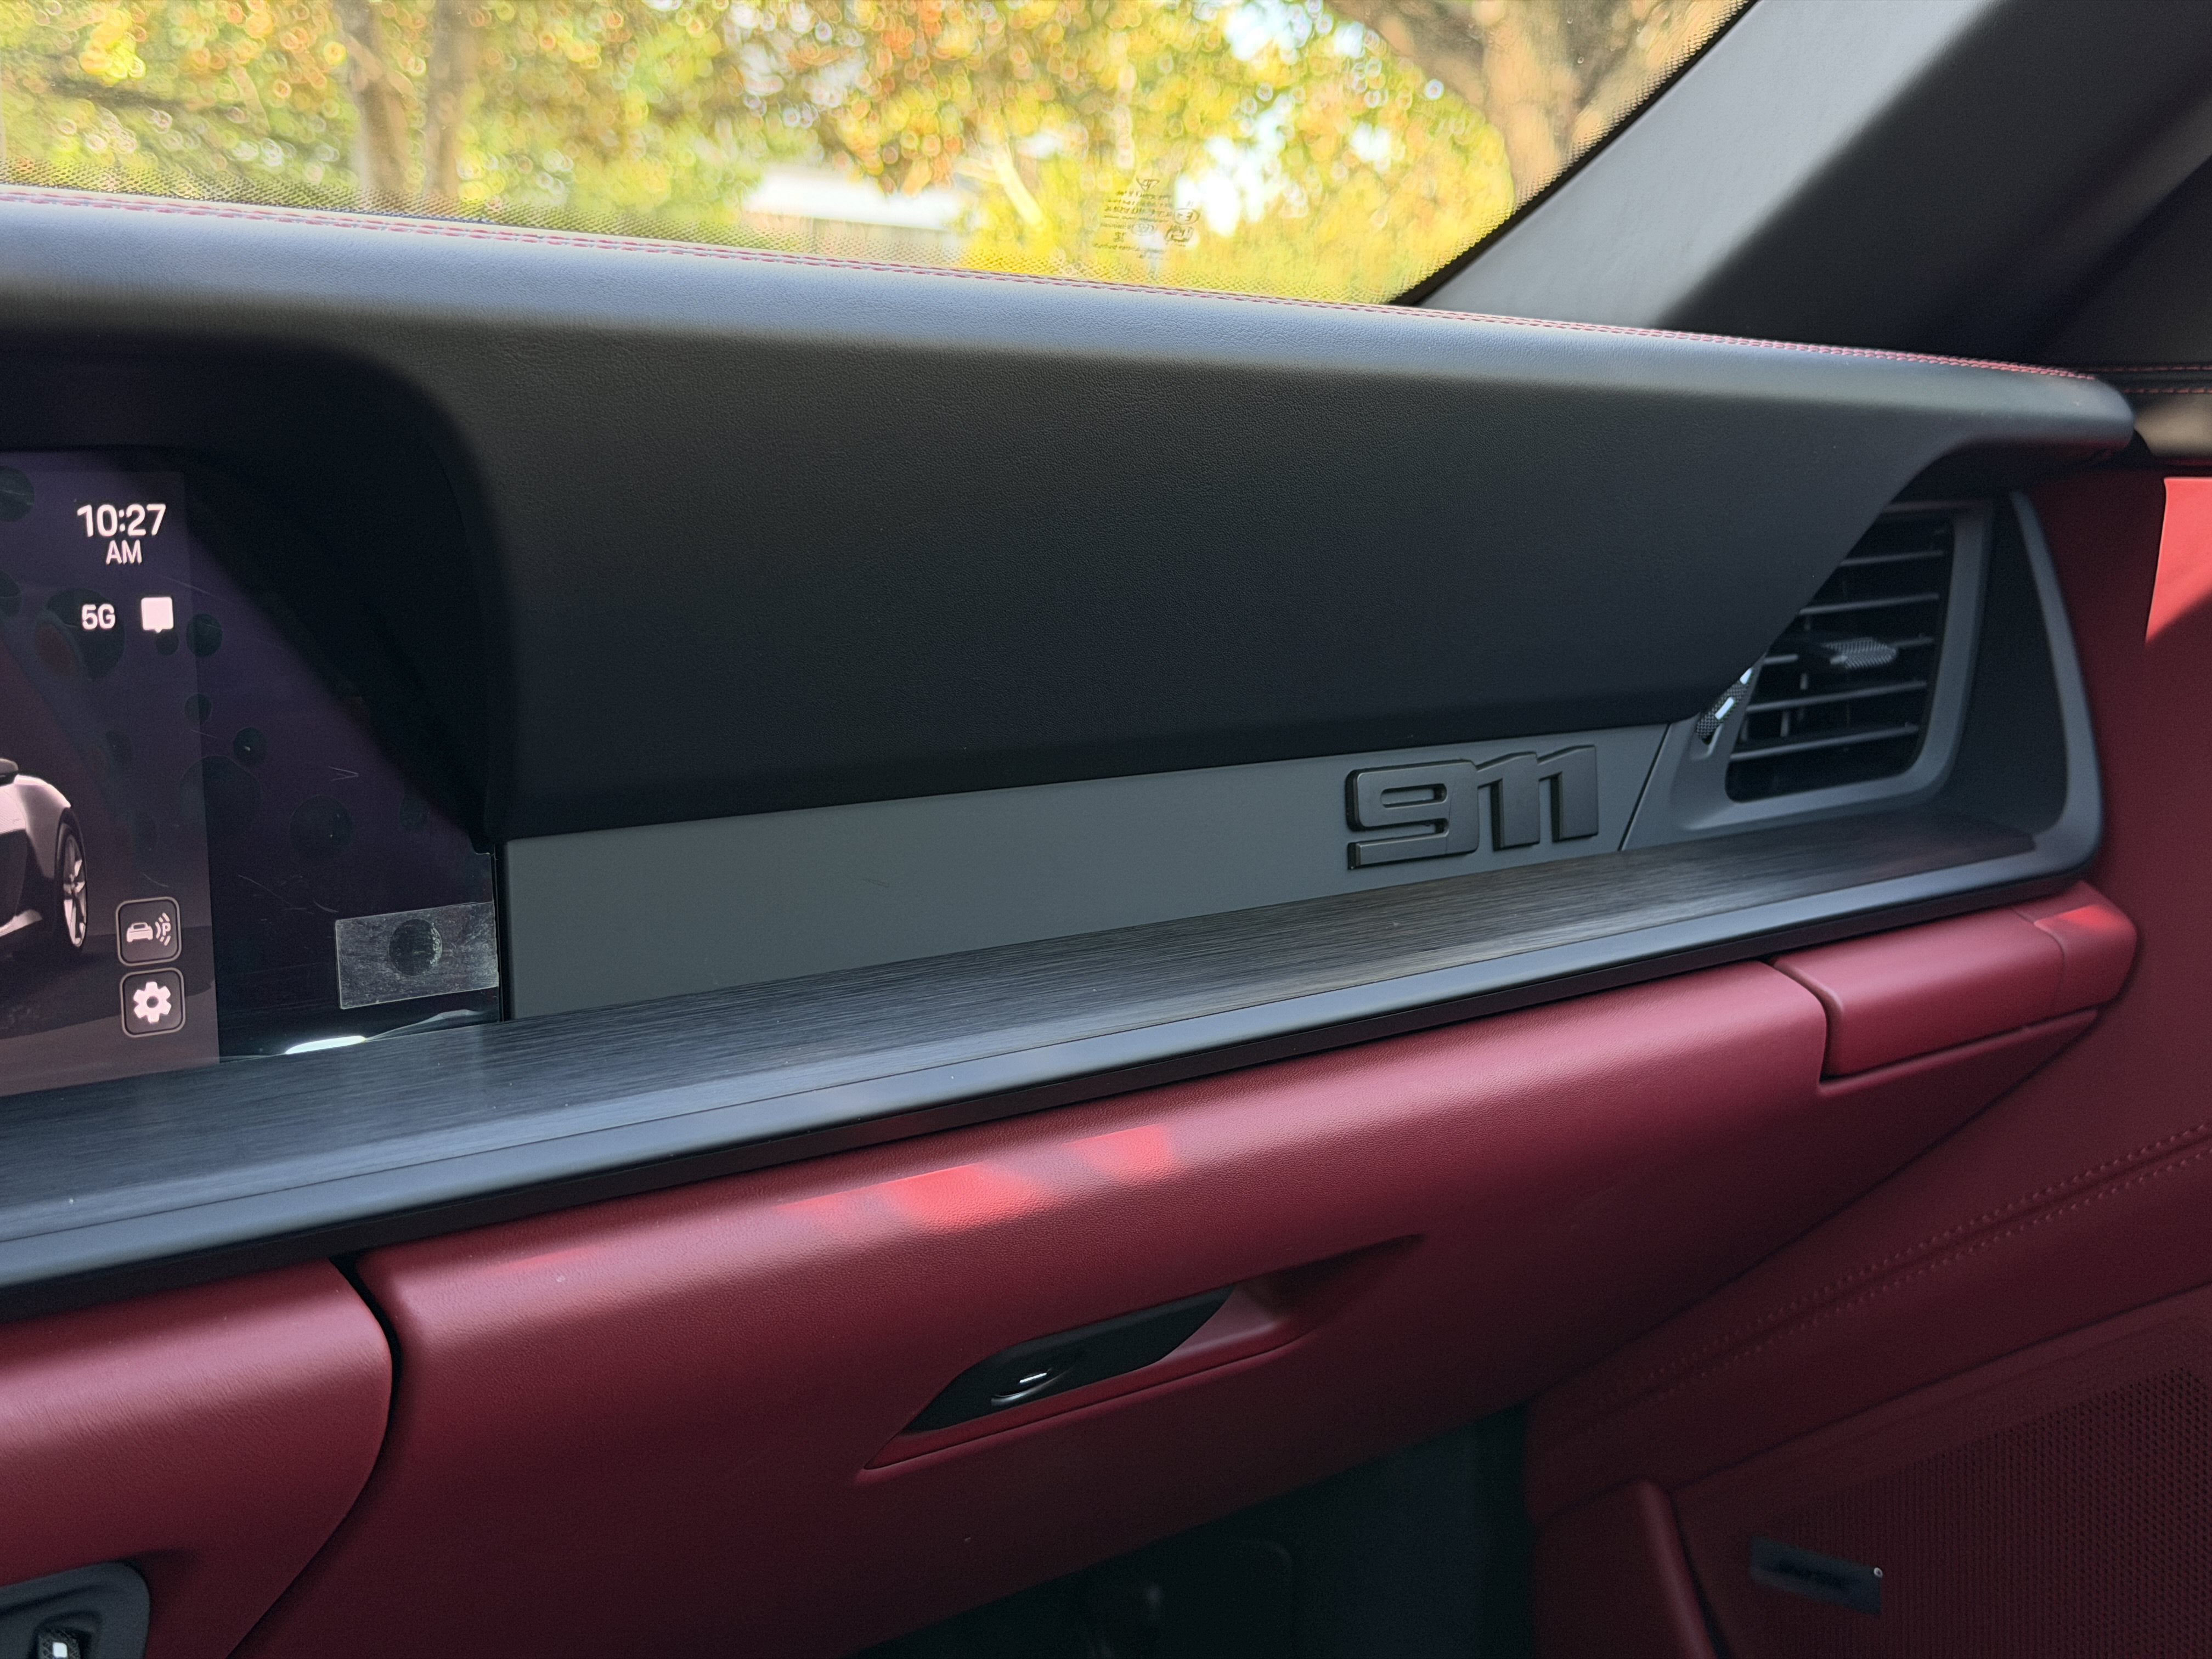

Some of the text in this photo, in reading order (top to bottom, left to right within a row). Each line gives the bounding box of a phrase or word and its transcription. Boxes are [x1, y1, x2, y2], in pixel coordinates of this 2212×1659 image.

[77, 504, 166, 537] 10:27
[106, 540, 142, 565] AM
[82, 604, 116, 630] 5G
[1345, 744, 1599, 870] 911
[162, 923, 171, 936] P
